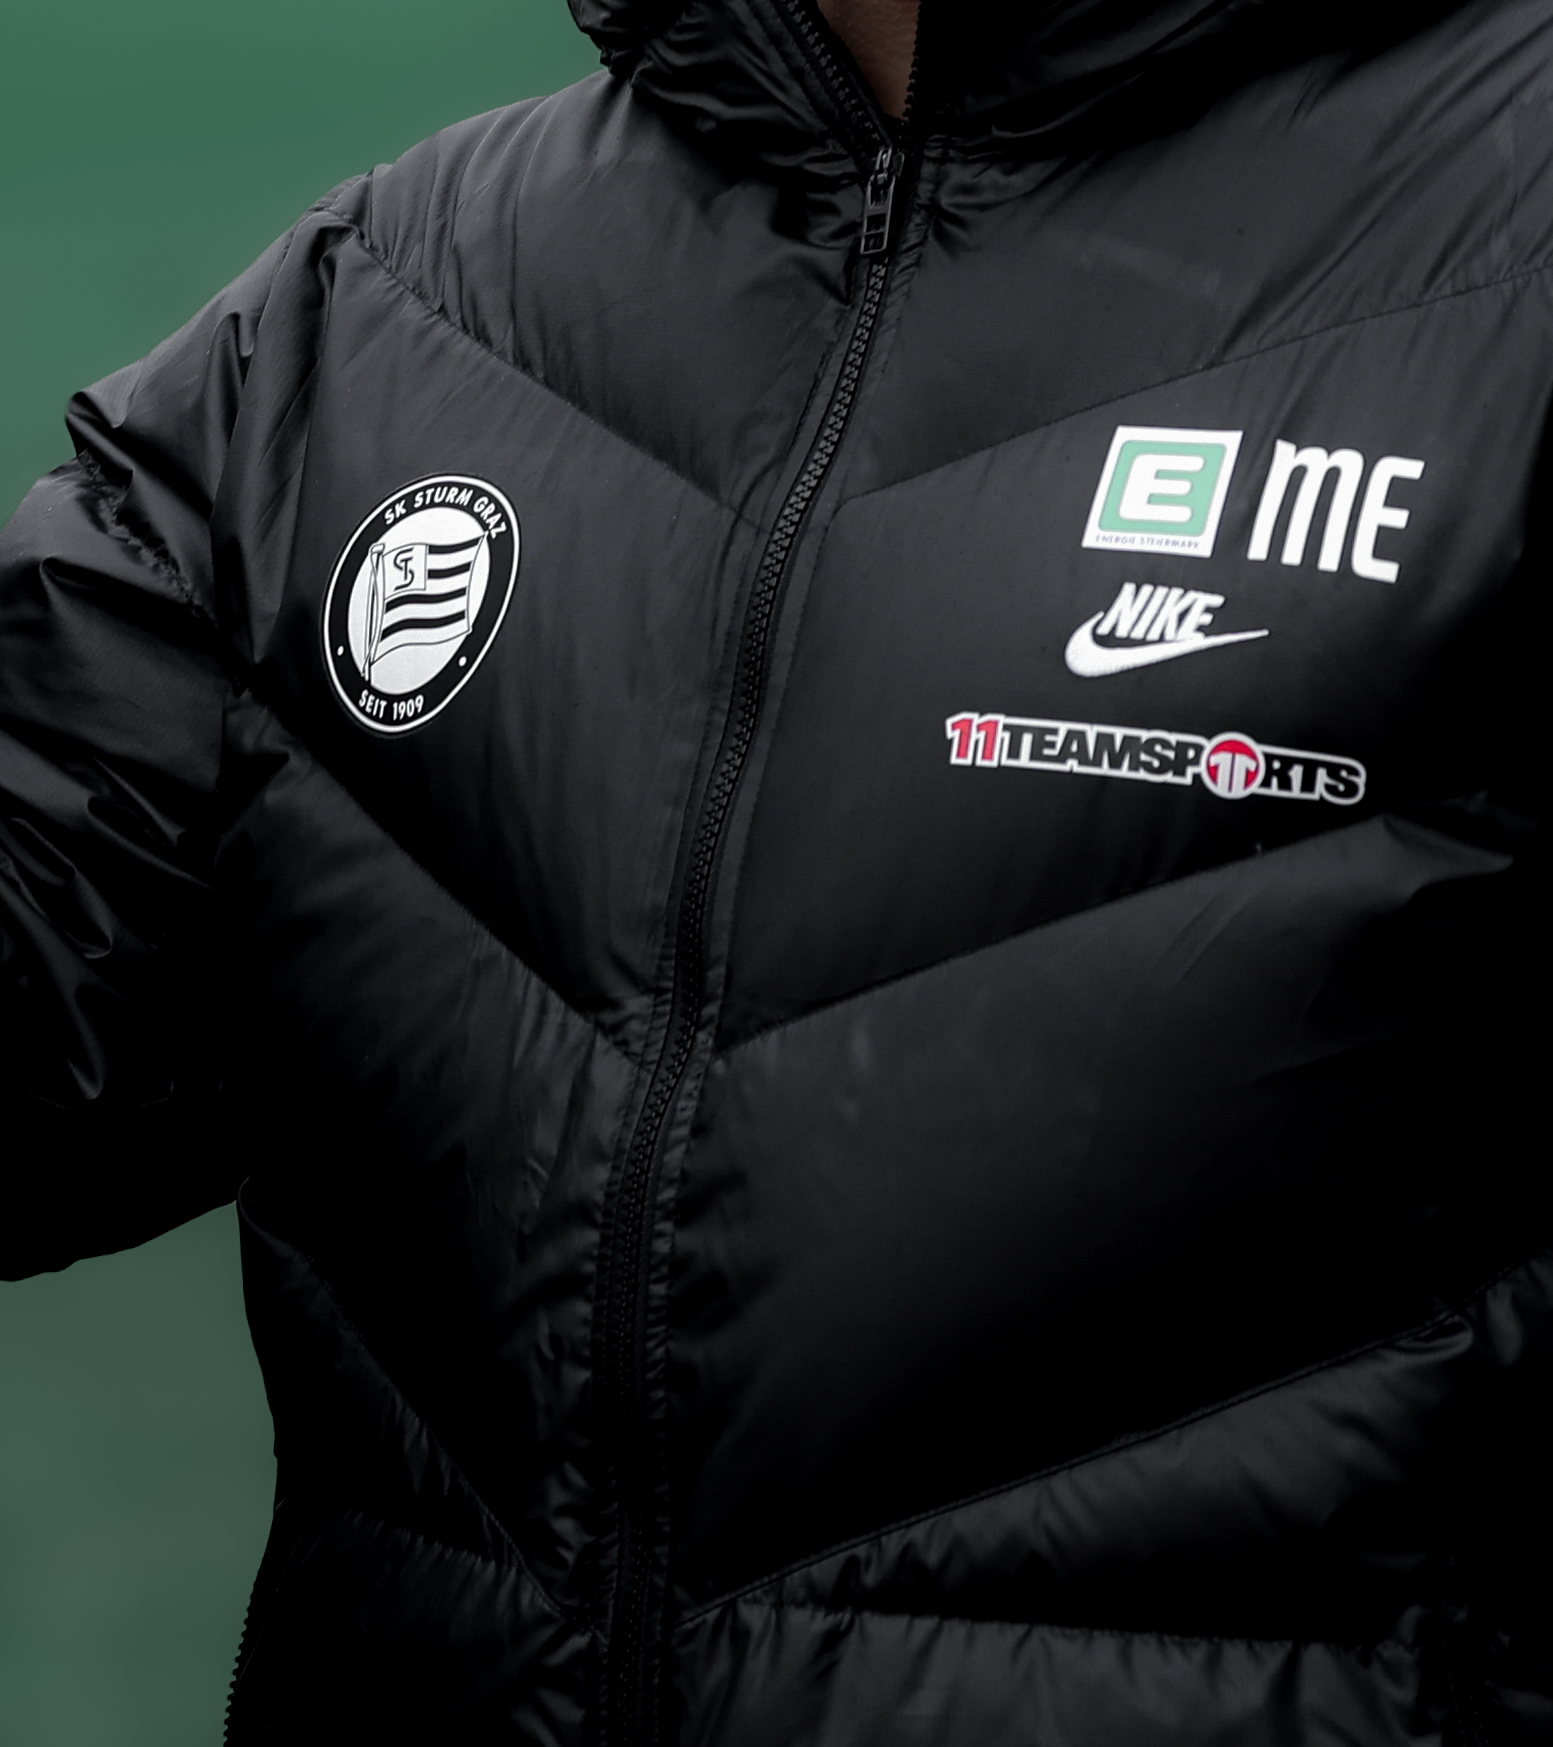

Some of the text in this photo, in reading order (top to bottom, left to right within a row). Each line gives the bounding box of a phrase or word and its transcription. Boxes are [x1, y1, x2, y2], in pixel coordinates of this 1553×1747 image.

[384, 486, 507, 540] SK STURM GRAZ
[1119, 453, 1205, 524] E
[1247, 440, 1424, 583] ME
[1096, 582, 1226, 641] NIKE
[358, 689, 424, 721] SEIT 1909
